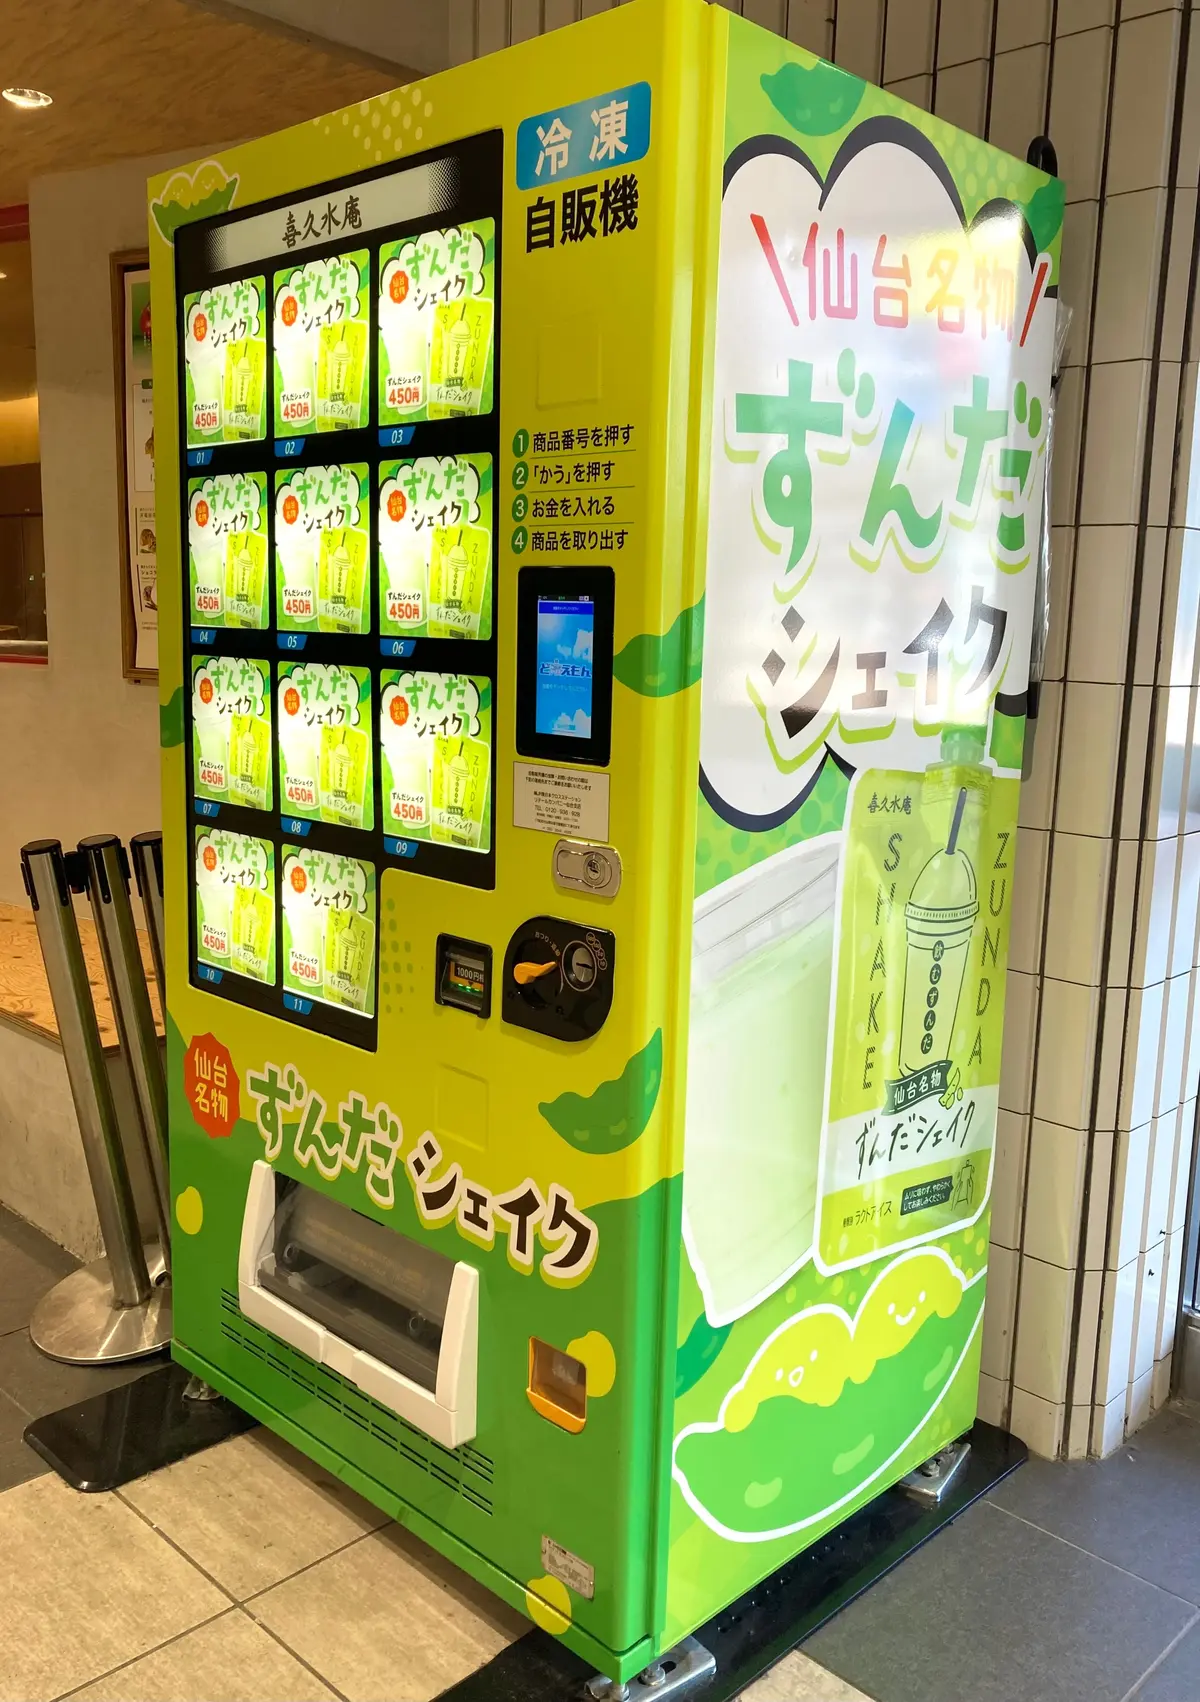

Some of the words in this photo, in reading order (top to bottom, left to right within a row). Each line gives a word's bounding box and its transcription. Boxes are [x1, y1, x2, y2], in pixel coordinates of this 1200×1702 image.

[535, 99, 628, 176] 冷凍
[282, 195, 362, 248] 喜久水庵
[526, 173, 639, 253] 自販機
[405, 229, 473, 285] ずんだ
[295, 260, 350, 309] ずんだ
[413, 274, 466, 312] シェイク
[802, 222, 1014, 342] 仙台名物
[204, 282, 251, 326] ずんだ
[302, 299, 345, 333] シェイク
[210, 318, 247, 348] シェイク
[468, 315, 481, 381] ZUNDA
[283, 402, 309, 419] 450円
[389, 388, 420, 405] 450円
[195, 412, 218, 428] 450円
[284, 441, 295, 455] 02
[391, 429, 402, 444] 03
[518, 434, 523, 453] 1
[533, 424, 635, 453] 商品番号を押す
[196, 452, 205, 464] 01
[735, 347, 1042, 577] ずんだ
[403, 460, 468, 506] ずんだ
[516, 467, 525, 485] 2
[534, 460, 615, 484] 「かう」を押す
[206, 478, 252, 514] ずんだ
[295, 470, 350, 511] ずんだ
[302, 505, 345, 533] シェイク
[411, 500, 461, 532] シェイク
[515, 499, 524, 517] 3
[532, 496, 615, 518] お金を入れる
[211, 510, 248, 535] シェイク
[514, 532, 524, 549] 4
[531, 529, 629, 551] 商品を取り出す
[196, 596, 219, 610] 450円
[285, 599, 311, 615] 450円
[389, 603, 420, 620] 450円
[199, 631, 208, 643] 04
[287, 635, 297, 648] 05
[392, 641, 404, 655] 06
[761, 585, 1008, 740] シェイク
[210, 662, 257, 695] ずんだ
[296, 670, 350, 705] ずんだ
[216, 695, 252, 716] シェイク
[405, 675, 467, 713] ずんだ
[303, 704, 345, 726] シェイク
[413, 713, 462, 738] シェイク
[201, 769, 223, 786] 450円
[469, 755, 480, 814] ZUNDA
[203, 803, 212, 815] 07
[288, 786, 313, 804] 450円
[867, 792, 912, 815] 喜久水庵
[393, 802, 423, 822] 450円
[291, 820, 301, 833] 08
[214, 836, 260, 867] ずんだ
[395, 841, 407, 855] 09
[219, 866, 256, 886] シェイク
[304, 854, 357, 889] ずんだ
[311, 888, 352, 910] シェイク
[203, 934, 226, 953] 450円
[967, 832, 1010, 1067] ZUNDA
[206, 968, 215, 979] 10
[291, 960, 317, 981] 450円
[863, 832, 903, 1090] SHAKE
[293, 998, 303, 1011] 11
[922, 941, 943, 1053] 飲むずんだ
[194, 1047, 228, 1089] 仙台
[893, 1069, 942, 1106] 仙台名物
[194, 1082, 229, 1123] 名物
[248, 1065, 401, 1202] ずんだ
[855, 1100, 976, 1181] ずんだシェイク
[410, 1136, 595, 1274] シェイク
[854, 1200, 893, 1226] ラクトアイス
